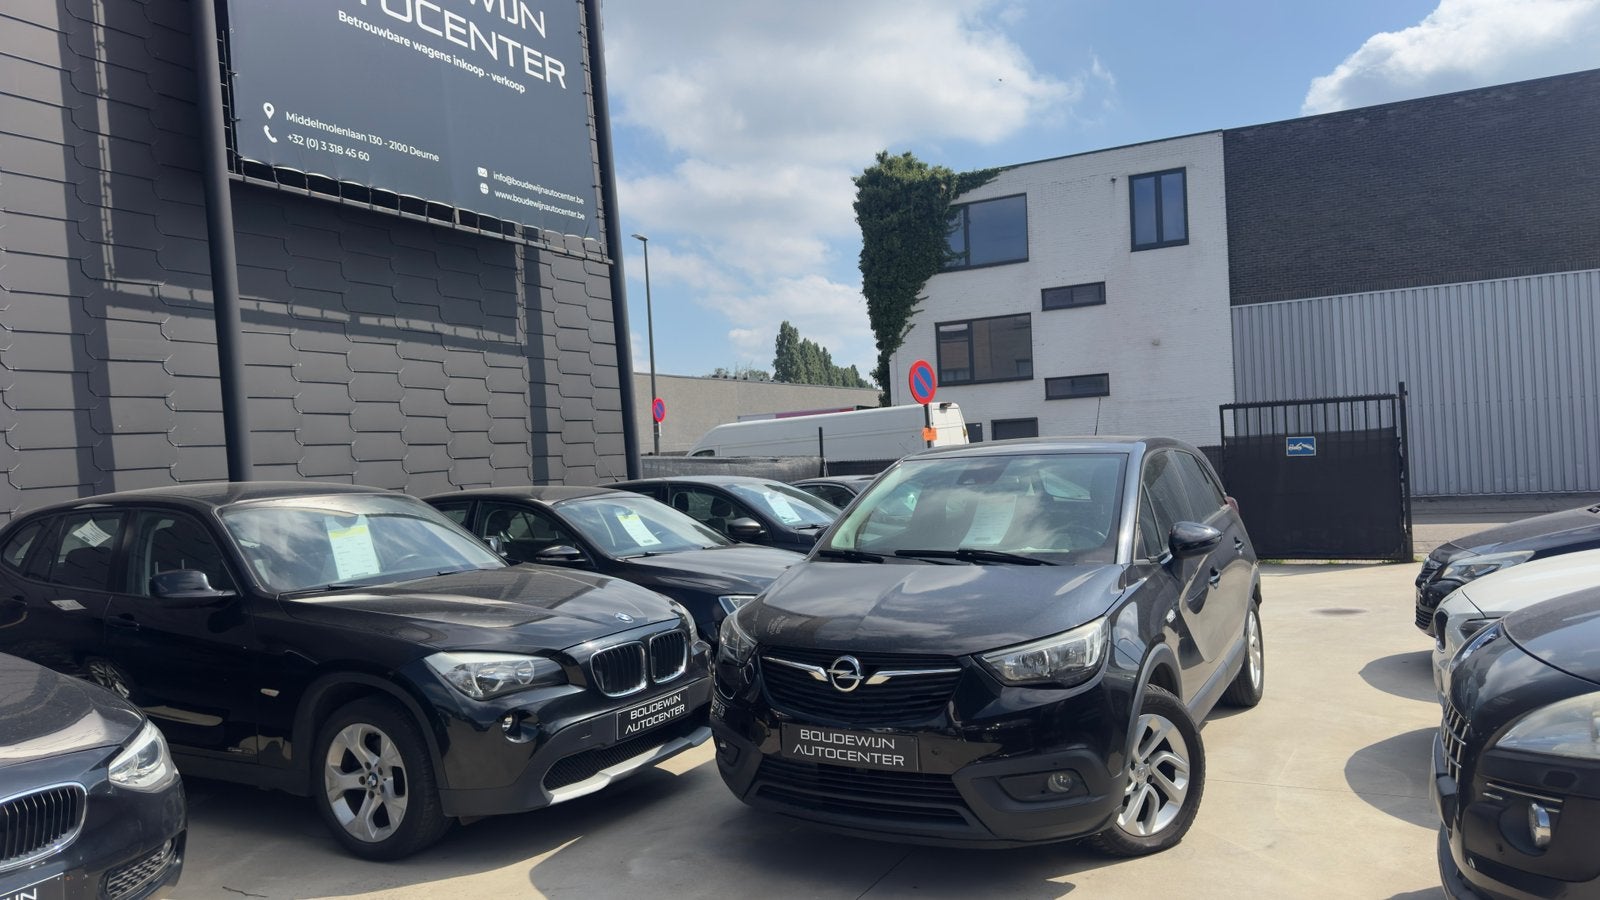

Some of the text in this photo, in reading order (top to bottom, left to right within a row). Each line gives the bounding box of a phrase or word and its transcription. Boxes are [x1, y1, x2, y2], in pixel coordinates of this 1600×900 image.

[338, 9, 411, 47] Betrouwbare
[412, 40, 452, 64] wagens
[452, 54, 485, 77] inkoop
[490, 72, 526, 94] verkoop
[285, 111, 367, 142] Middelmolenlaan
[367, 133, 383, 146] 130
[388, 140, 408, 153] 2100
[409, 145, 440, 162] Deurne
[287, 133, 370, 162] +32 (0) 3 318 45 60
[492, 170, 585, 205] info@boudewijnautocenter.be
[494, 189, 586, 221] www.boudewijnautocenter.be
[625, 703, 685, 735] AUTOCENTER
[630, 693, 681, 720] BOUDEWIJN
[793, 743, 905, 767] AUTOCENTER
[800, 728, 895, 750] BOUDEWIJN
